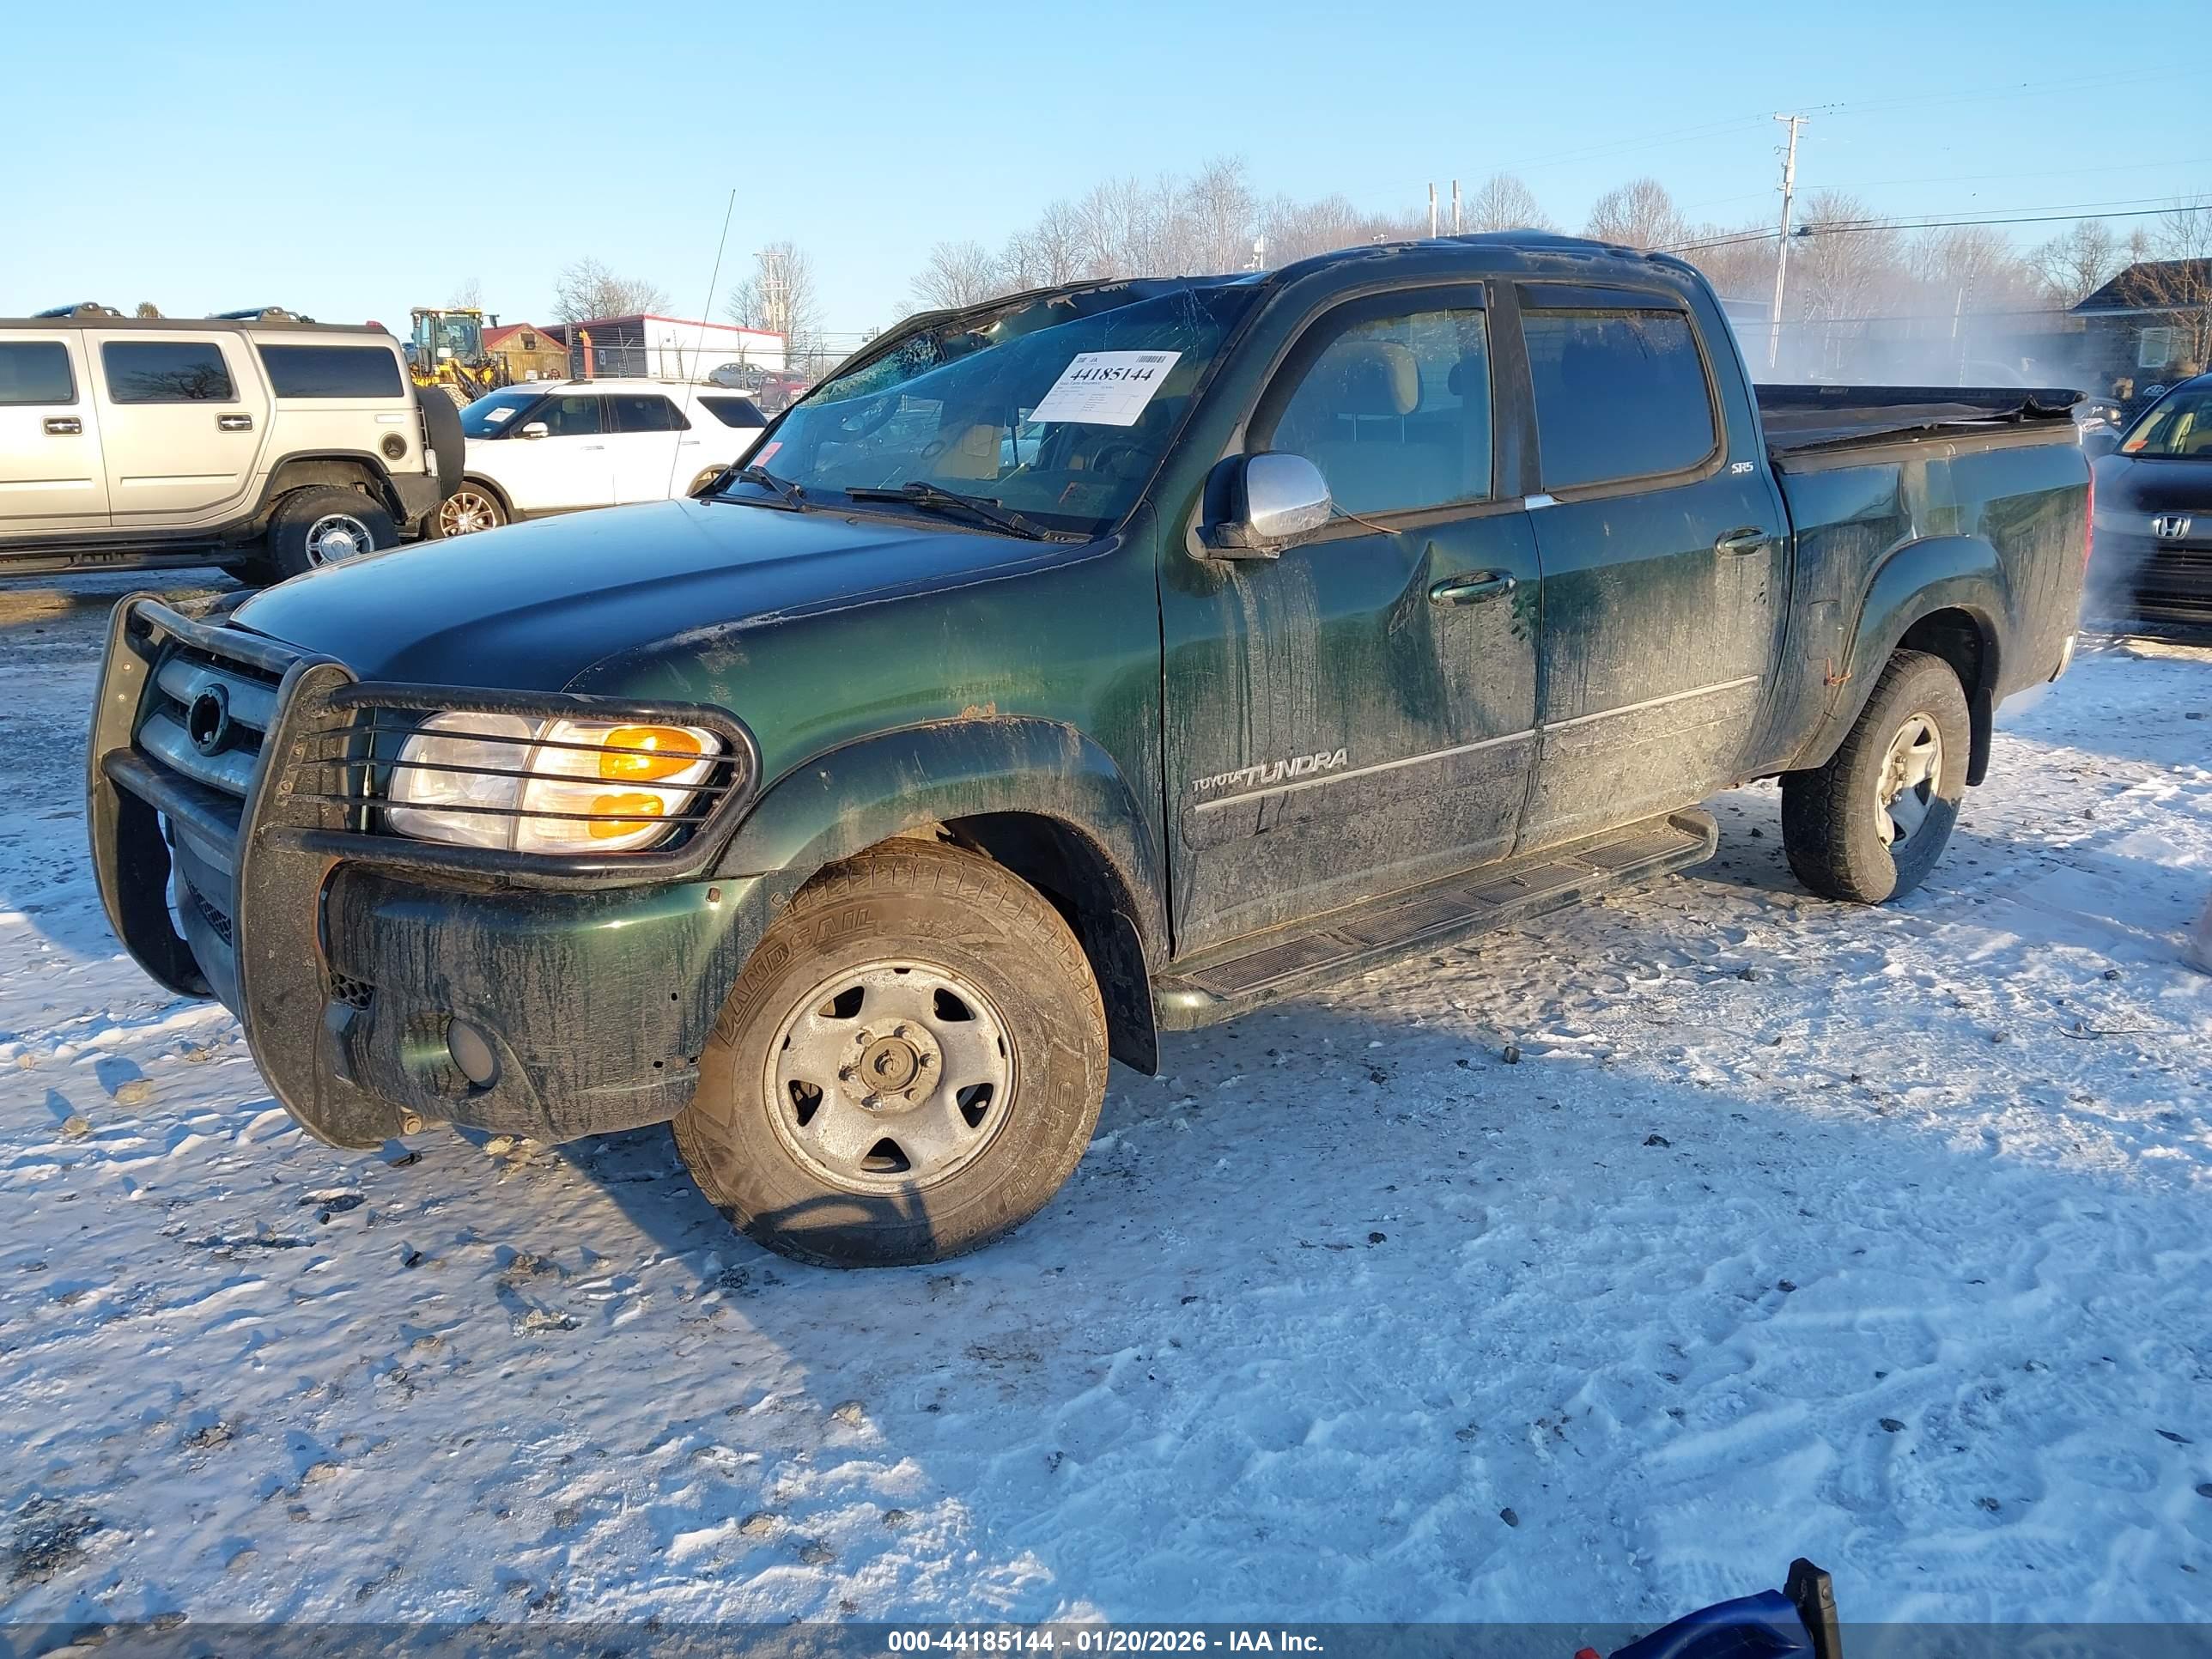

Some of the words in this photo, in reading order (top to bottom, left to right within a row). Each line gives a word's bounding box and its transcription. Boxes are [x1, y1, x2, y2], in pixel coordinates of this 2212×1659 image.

[1070, 367, 1155, 381] 44185144
[1730, 461, 1754, 475] SR5
[1191, 771, 1243, 793] TOYOTA
[1243, 747, 1349, 787] TUNDRA
[714, 908, 874, 1048] LANDSAIL
